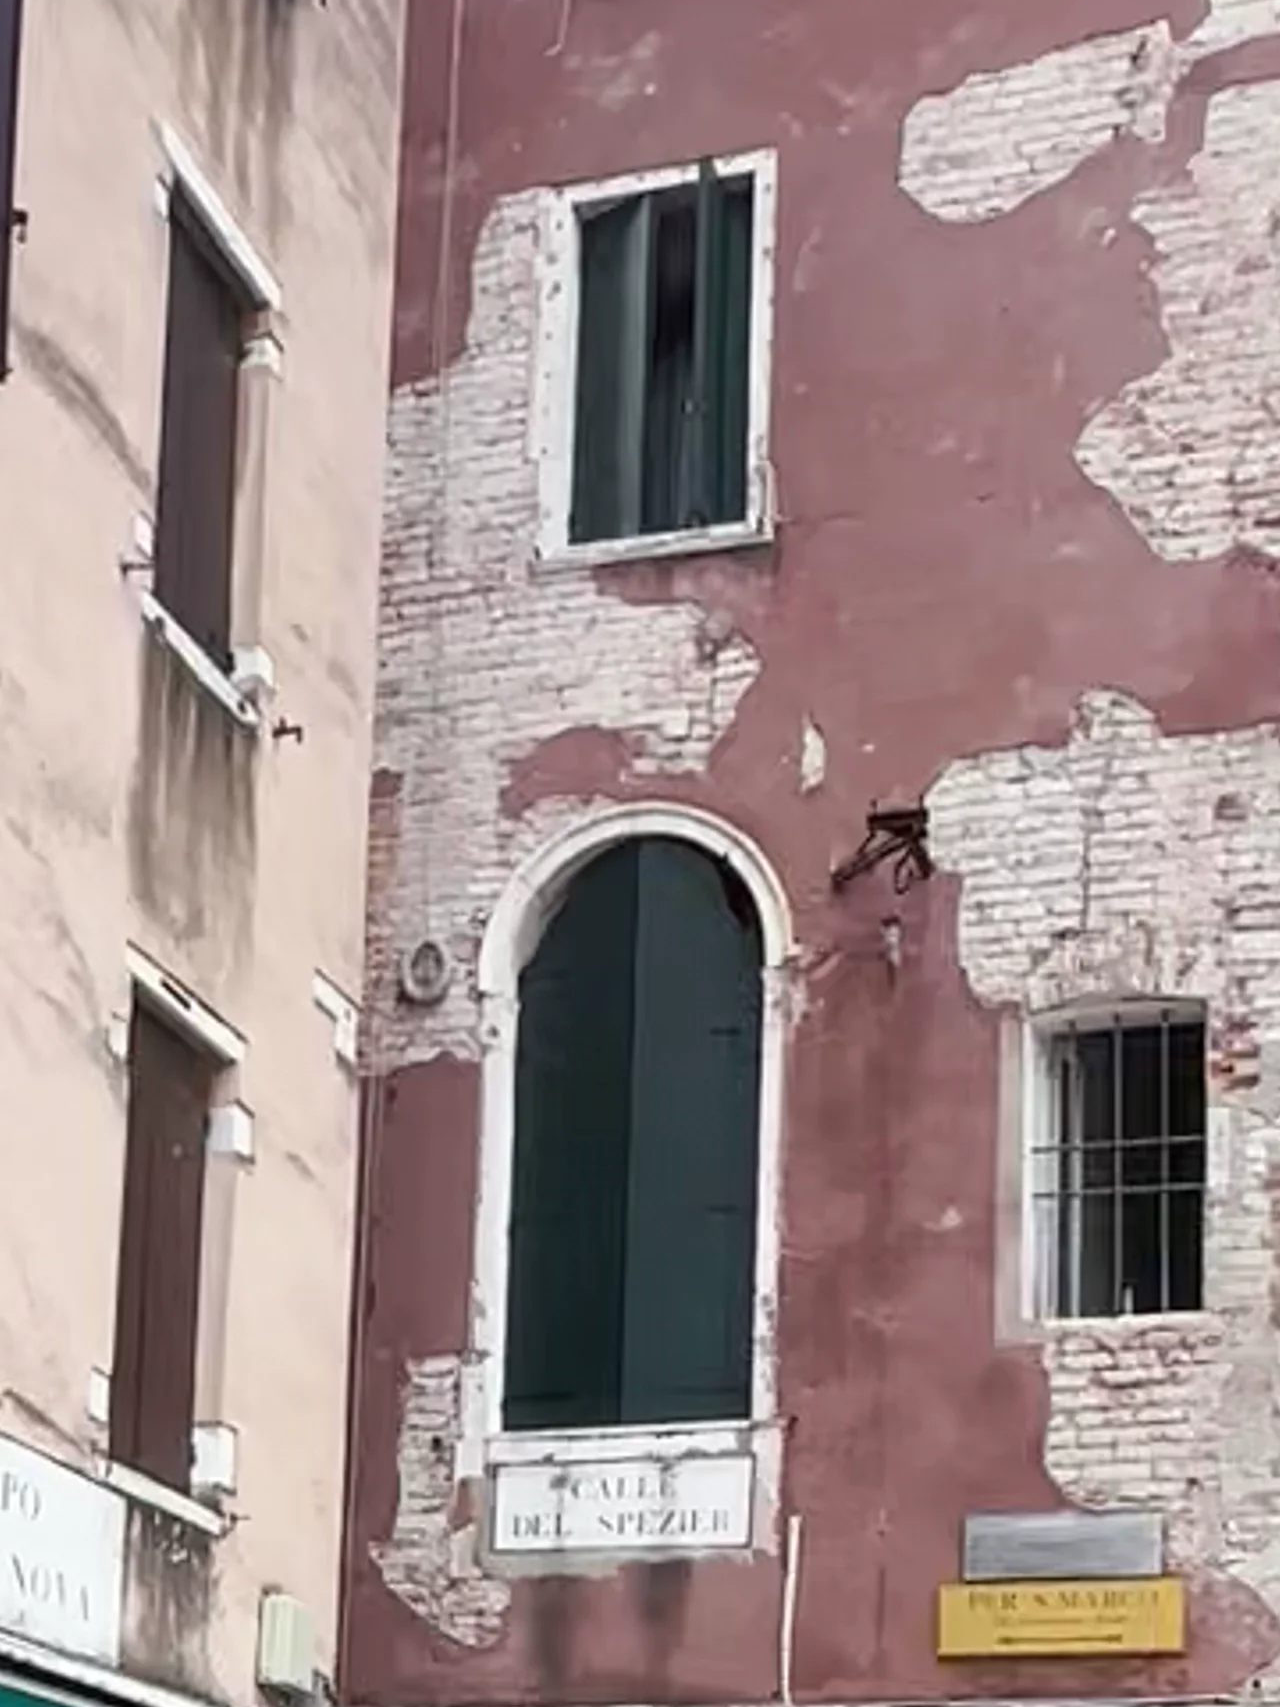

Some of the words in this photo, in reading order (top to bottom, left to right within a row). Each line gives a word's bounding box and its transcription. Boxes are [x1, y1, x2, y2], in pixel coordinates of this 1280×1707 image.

[569, 1475, 678, 1499] CALLE
[512, 1511, 570, 1537] DEL
[598, 1506, 730, 1535] SPEZIER
[10, 1552, 90, 1623] NOVA
